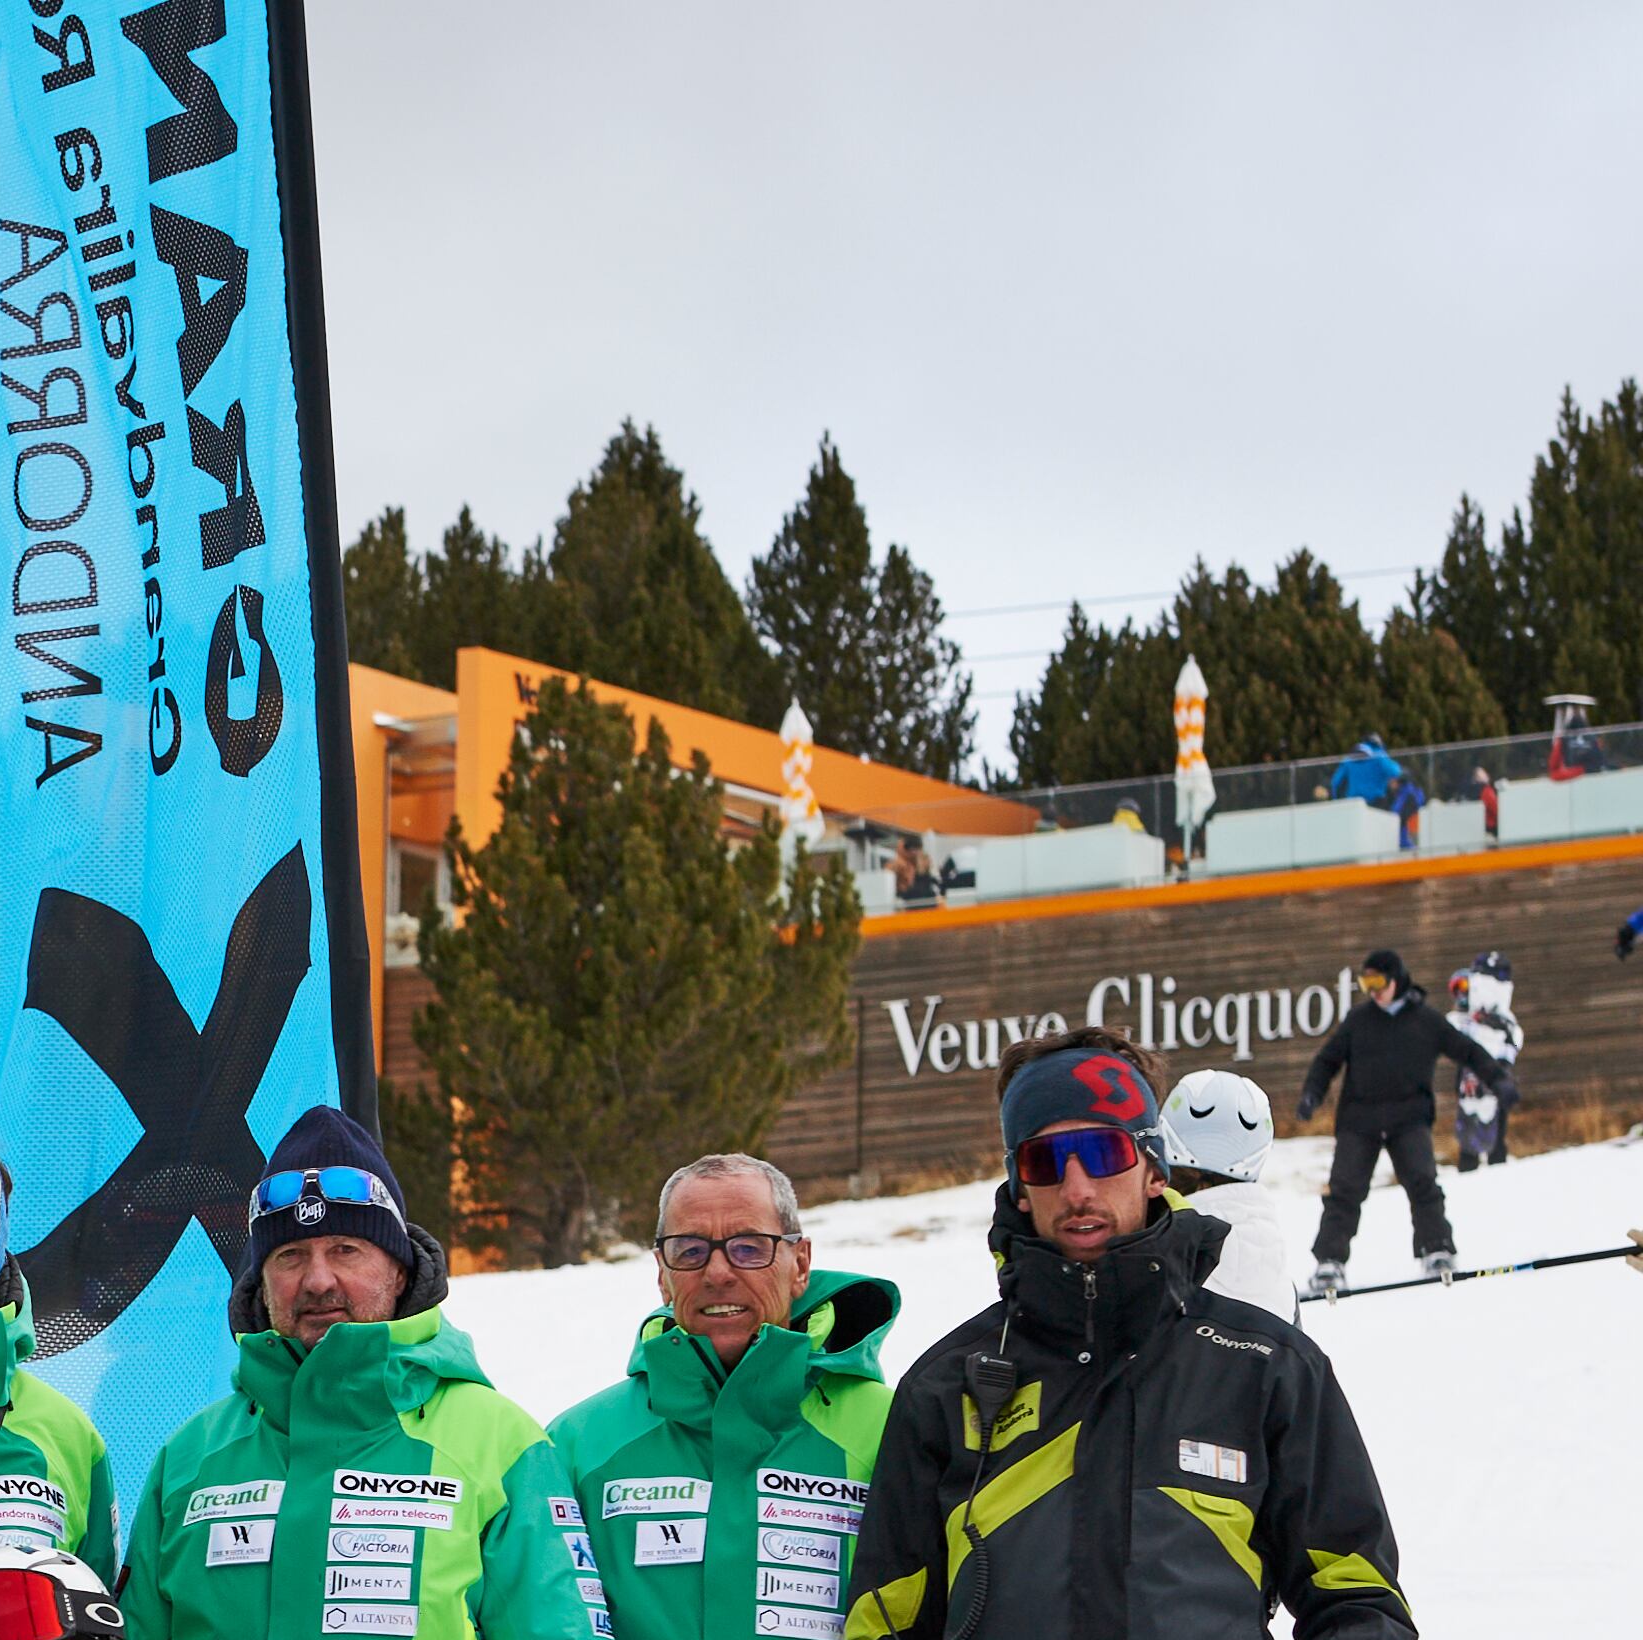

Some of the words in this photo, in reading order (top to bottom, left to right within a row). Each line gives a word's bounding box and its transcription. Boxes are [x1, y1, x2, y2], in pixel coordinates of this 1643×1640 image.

[354, 1508, 399, 1518] andorra
[402, 1509, 448, 1522] telecom
[780, 1507, 824, 1520] andorra
[356, 1534, 387, 1543] AUTO
[784, 1537, 815, 1547] AUTO
[353, 1543, 409, 1554] FACTORIA
[782, 1546, 837, 1561] FACTORIA
[351, 1614, 413, 1626] ALTAVISTA
[785, 1616, 843, 1635] ALTAVISTA
